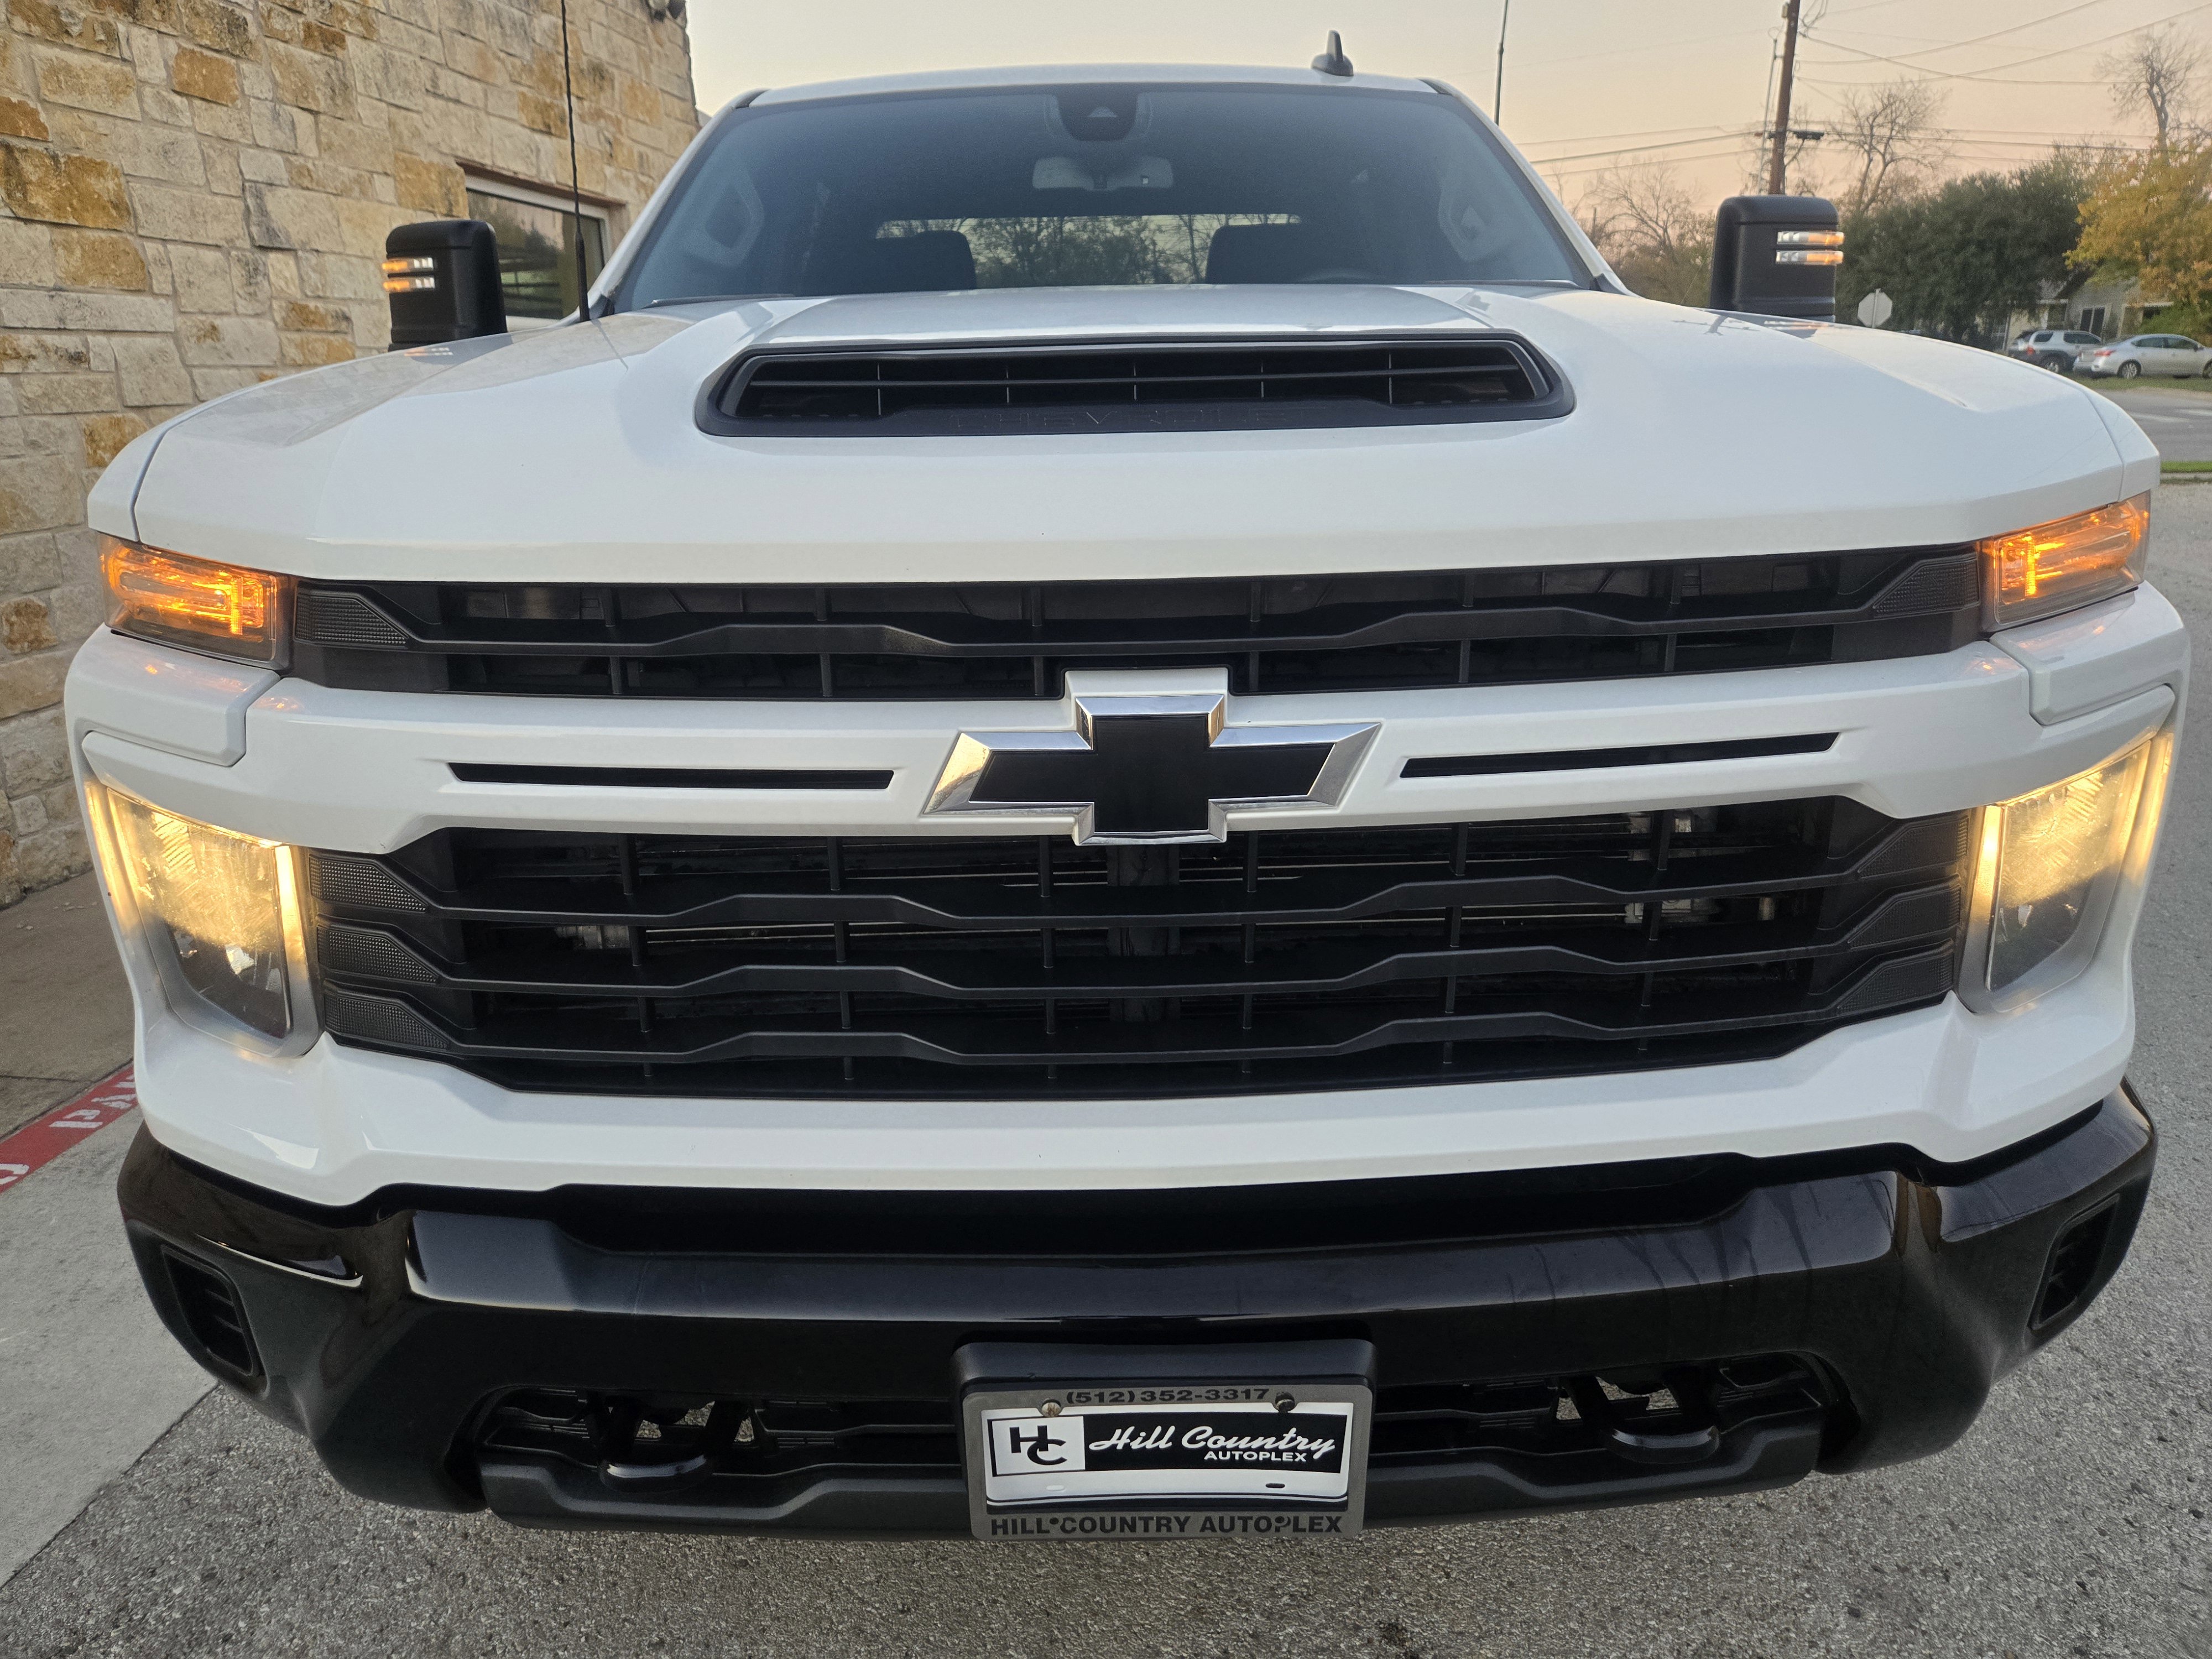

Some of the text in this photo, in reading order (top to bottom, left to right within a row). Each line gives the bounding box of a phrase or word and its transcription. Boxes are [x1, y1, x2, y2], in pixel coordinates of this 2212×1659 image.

[1009, 1425, 1068, 1465] HC
[1088, 1425, 1335, 1460] Hill Country
[1203, 1451, 1307, 1462] AUTOPLEX
[991, 1515, 1343, 1536] HILL COUNTRY AUTOPLEX
